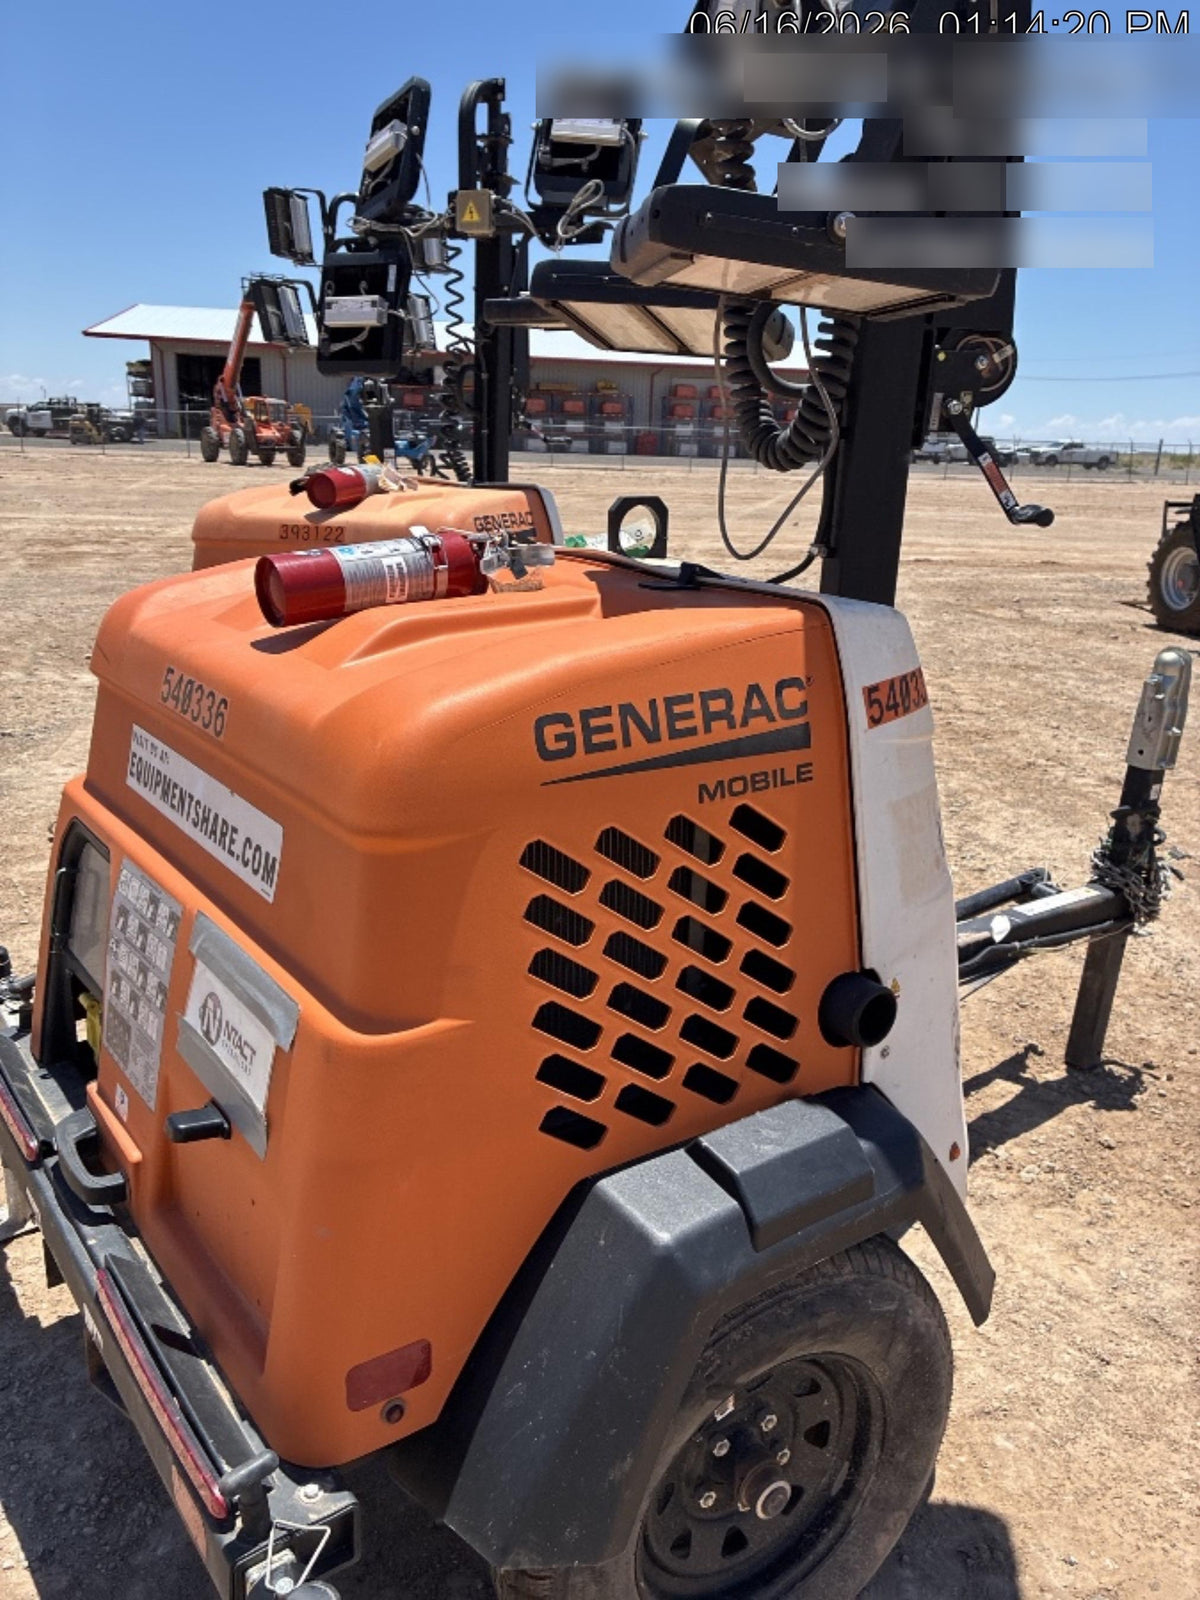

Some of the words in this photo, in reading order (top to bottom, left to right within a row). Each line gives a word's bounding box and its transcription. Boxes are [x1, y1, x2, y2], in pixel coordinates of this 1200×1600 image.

[474, 512, 533, 533] GENERAC
[160, 666, 229, 738] 540336
[534, 676, 810, 762] GENERAC
[698, 762, 814, 804] MOBILE
[129, 751, 277, 889] EQUIPMENTSHARE.COM
